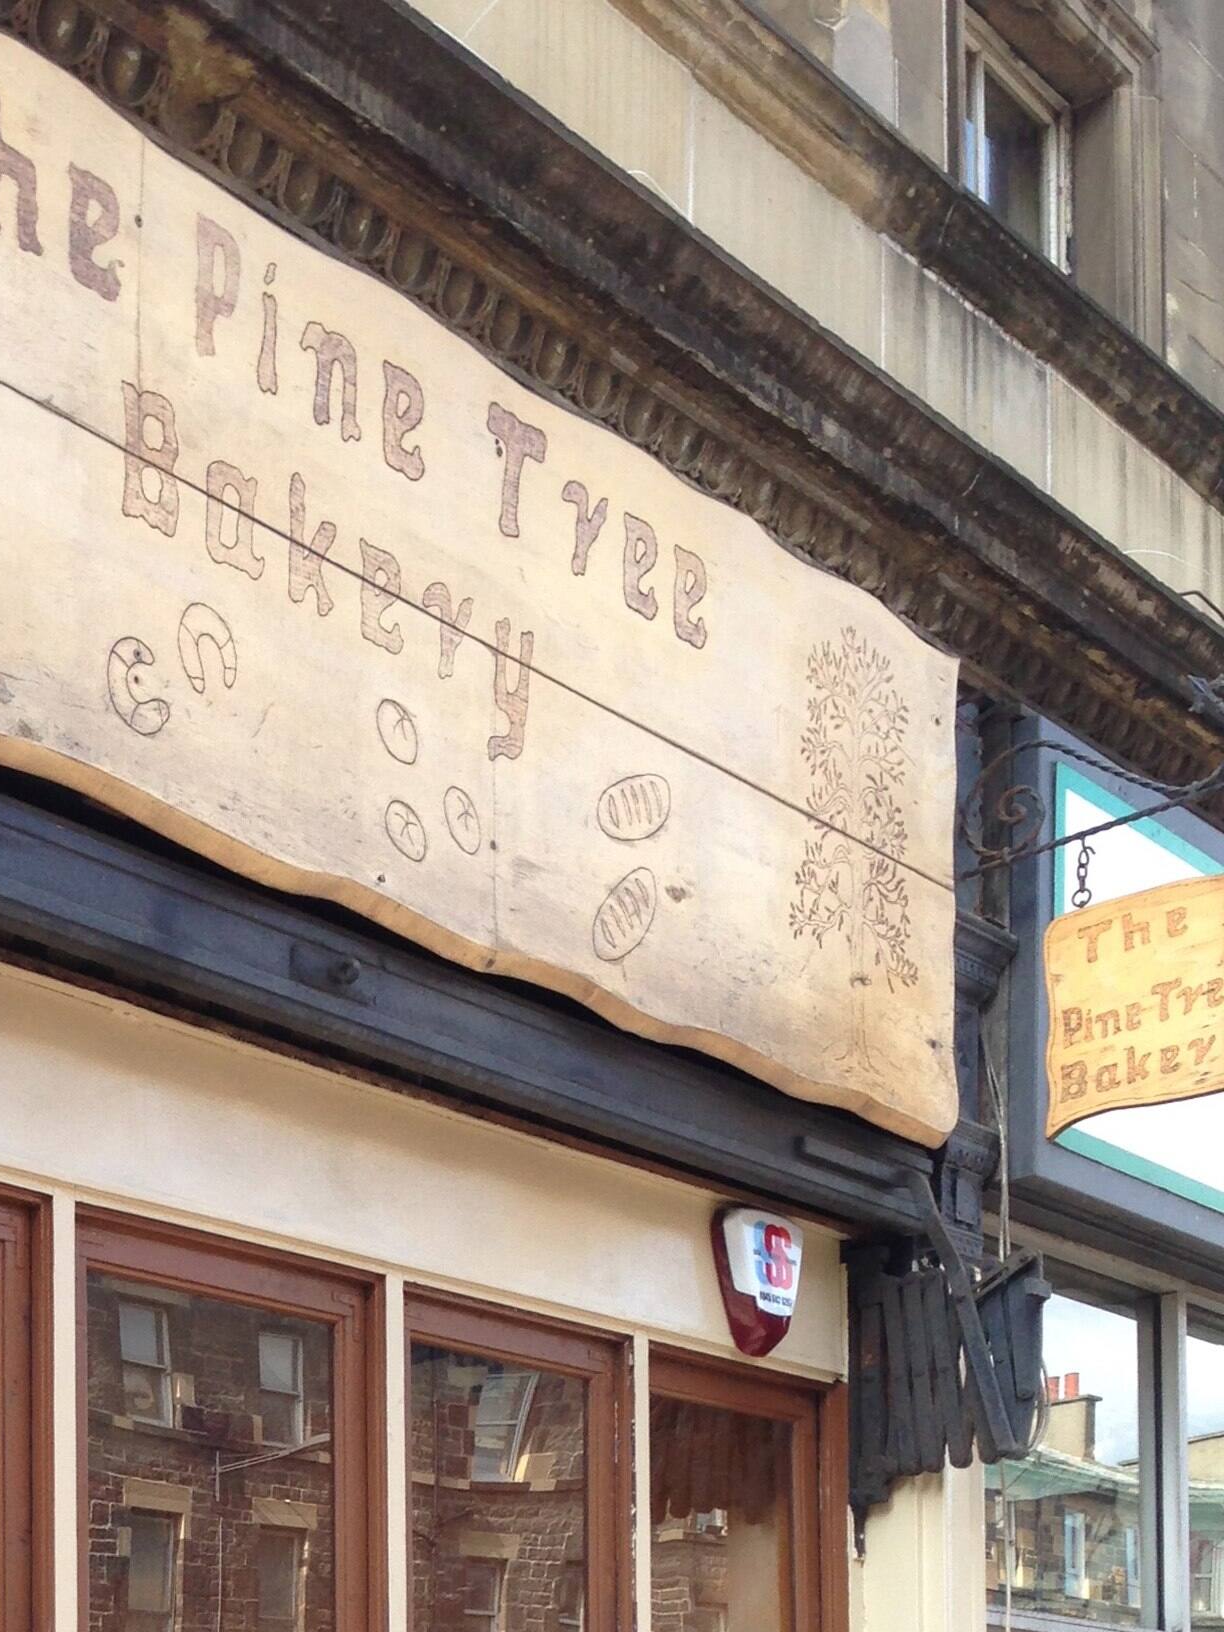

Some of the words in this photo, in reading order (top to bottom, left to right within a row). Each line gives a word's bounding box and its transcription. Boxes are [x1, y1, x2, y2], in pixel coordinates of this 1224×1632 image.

[194, 212, 427, 481] Pine
[486, 401, 708, 650] Tree
[121, 379, 535, 762] Bakery
[1061, 1002, 1142, 1049] Pine
[1078, 906, 1189, 964] The
